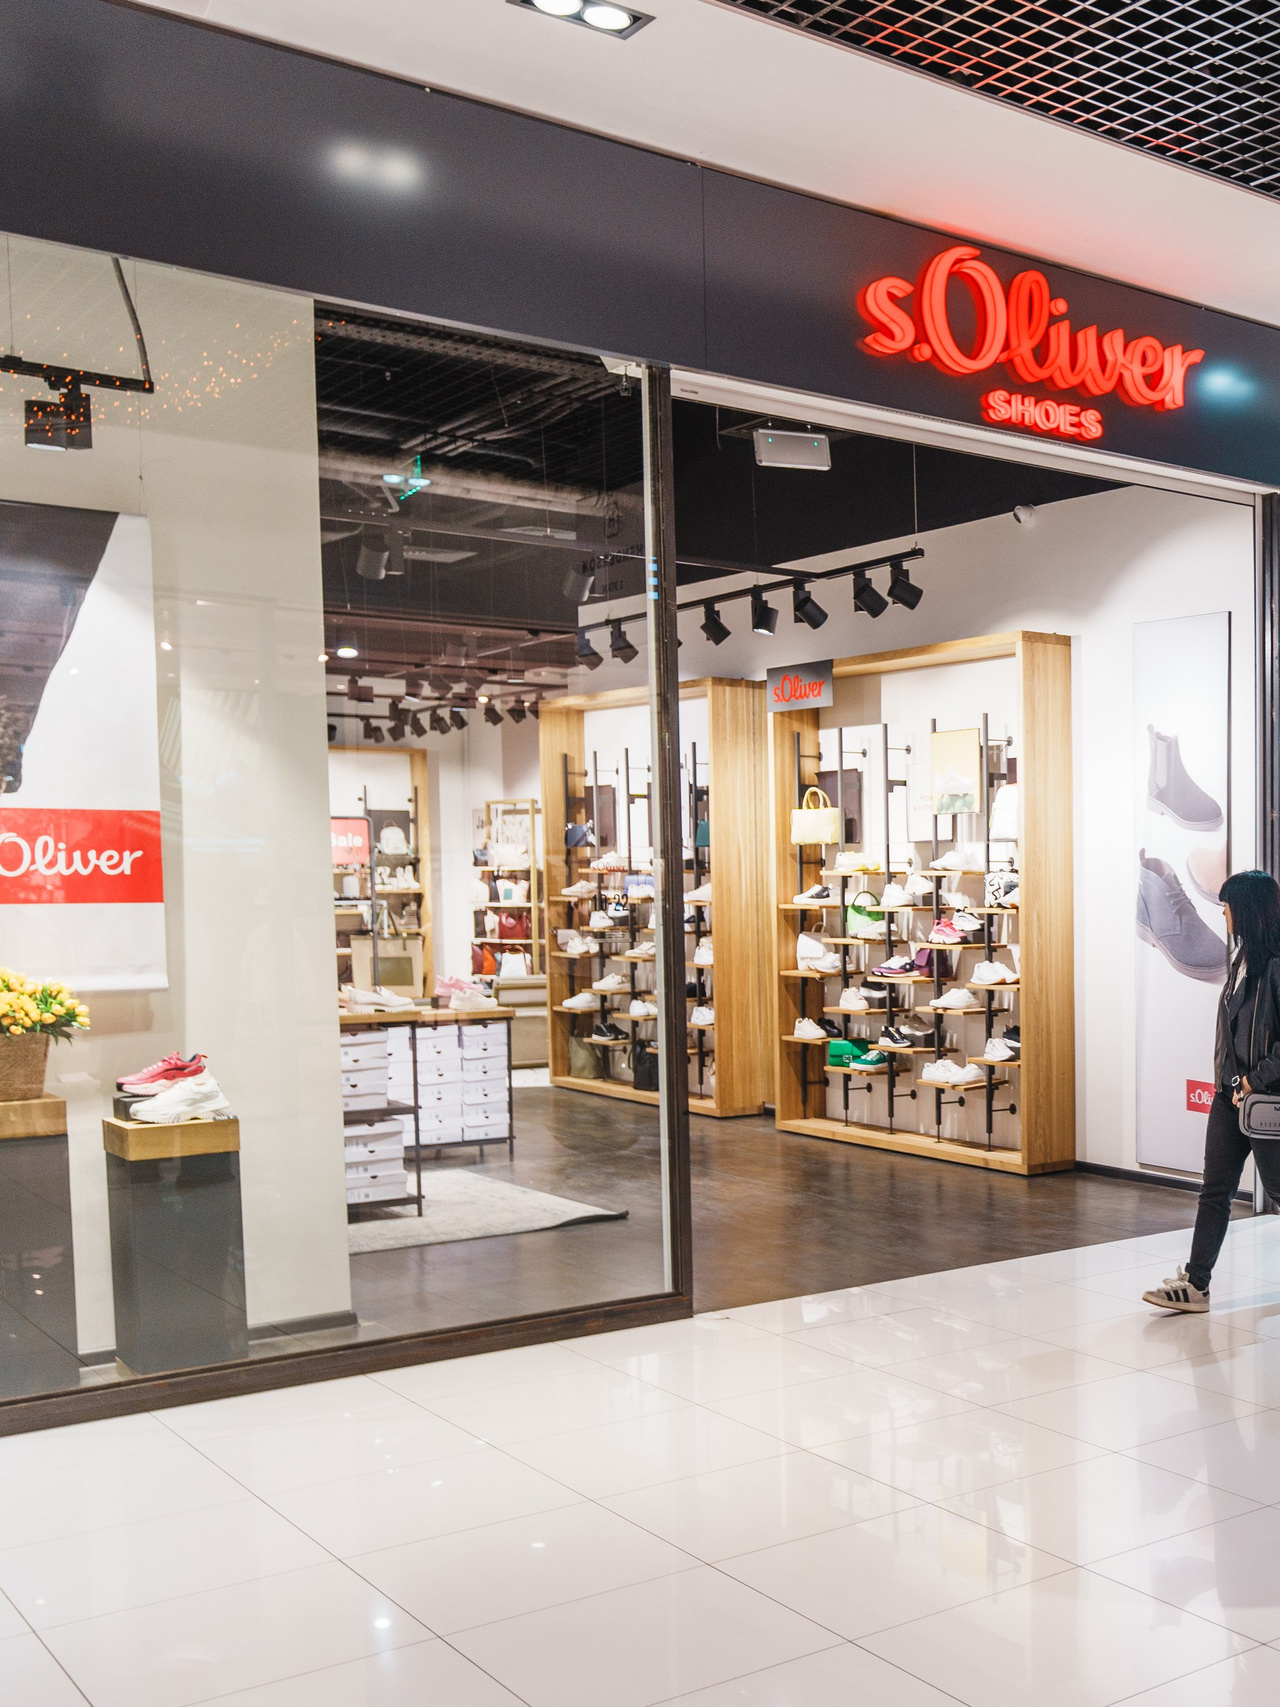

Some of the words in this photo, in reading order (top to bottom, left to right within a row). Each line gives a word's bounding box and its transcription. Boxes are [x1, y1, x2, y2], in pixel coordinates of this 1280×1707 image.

[860, 245, 1205, 411] s.Oliver
[985, 389, 1103, 440] SHOES
[773, 674, 825, 703] s.Oliver
[0, 832, 143, 877] Oliver
